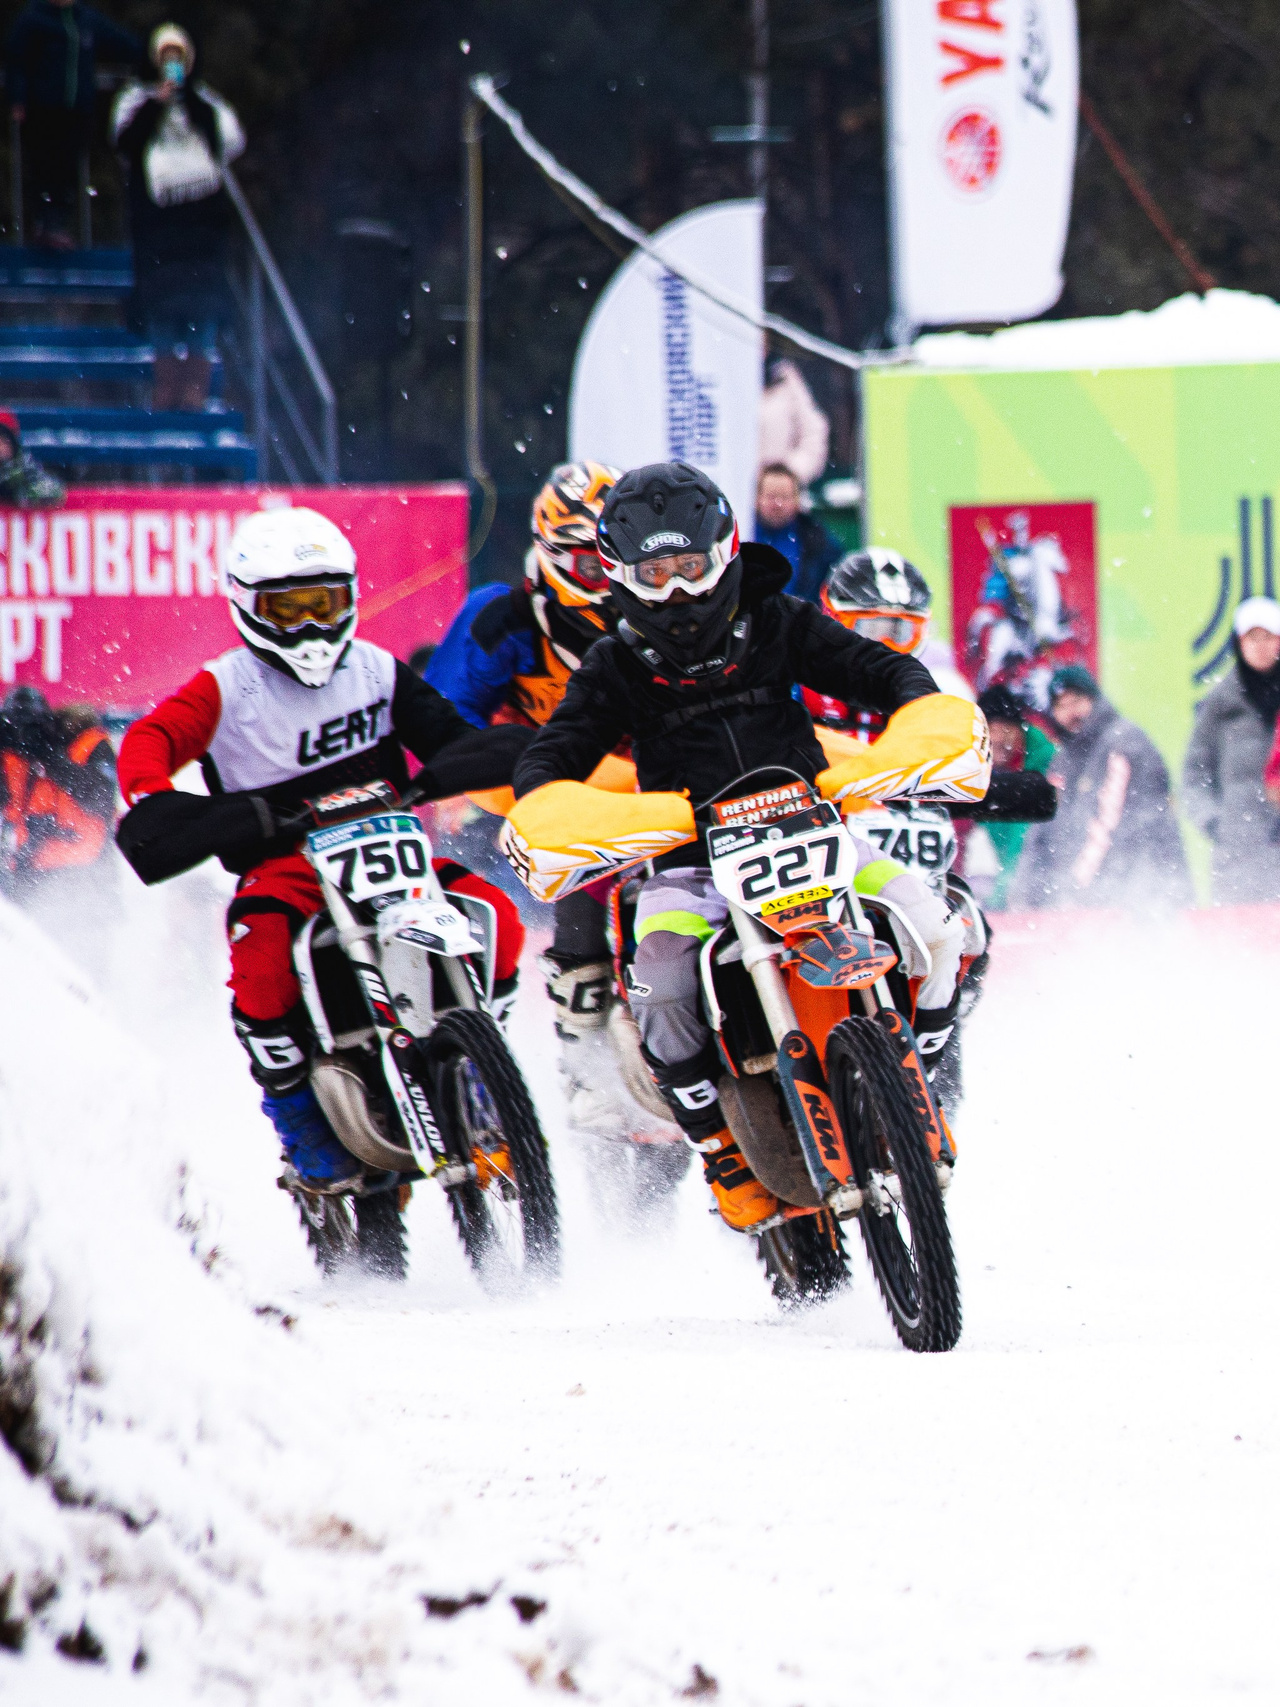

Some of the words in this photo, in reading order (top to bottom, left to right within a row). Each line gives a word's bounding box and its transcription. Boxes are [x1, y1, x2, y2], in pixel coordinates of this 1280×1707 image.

[646, 532, 685, 550] SHOEI
[720, 786, 803, 817] RENTHAL
[326, 839, 427, 894] 750
[738, 836, 840, 901] 227
[868, 828, 942, 869] 748
[765, 886, 830, 912] ACERBIS
[803, 1093, 841, 1161] KTM
